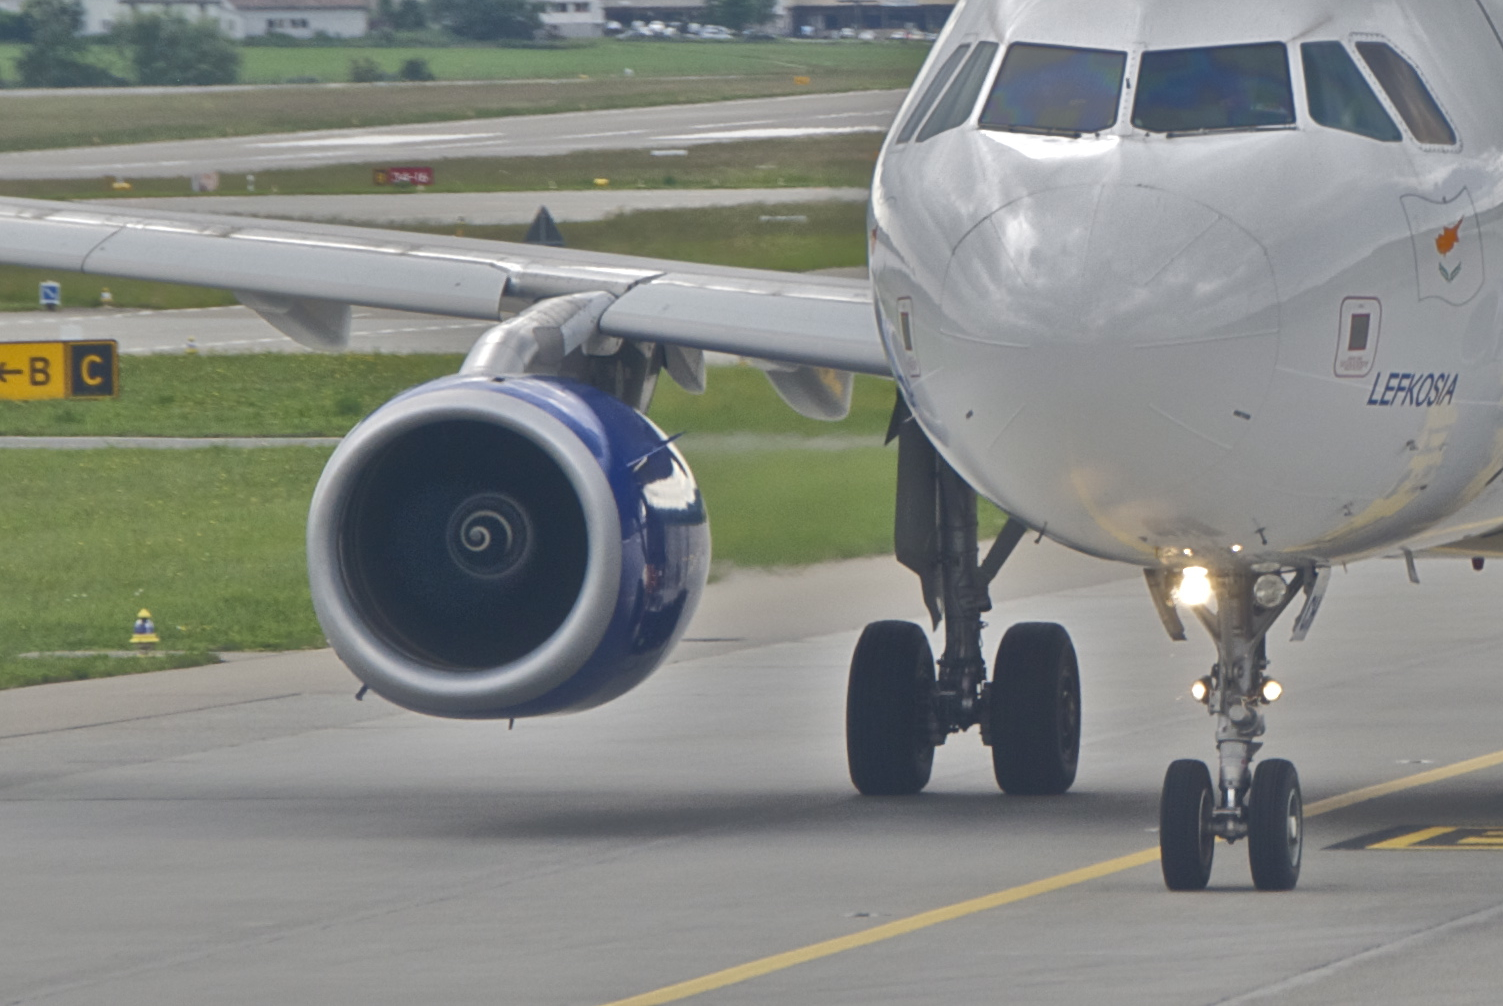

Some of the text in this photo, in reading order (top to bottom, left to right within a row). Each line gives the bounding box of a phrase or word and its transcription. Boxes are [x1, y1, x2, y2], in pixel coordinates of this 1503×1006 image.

[29, 354, 104, 387] B C
[1366, 371, 1460, 407] LEFKOSIA
